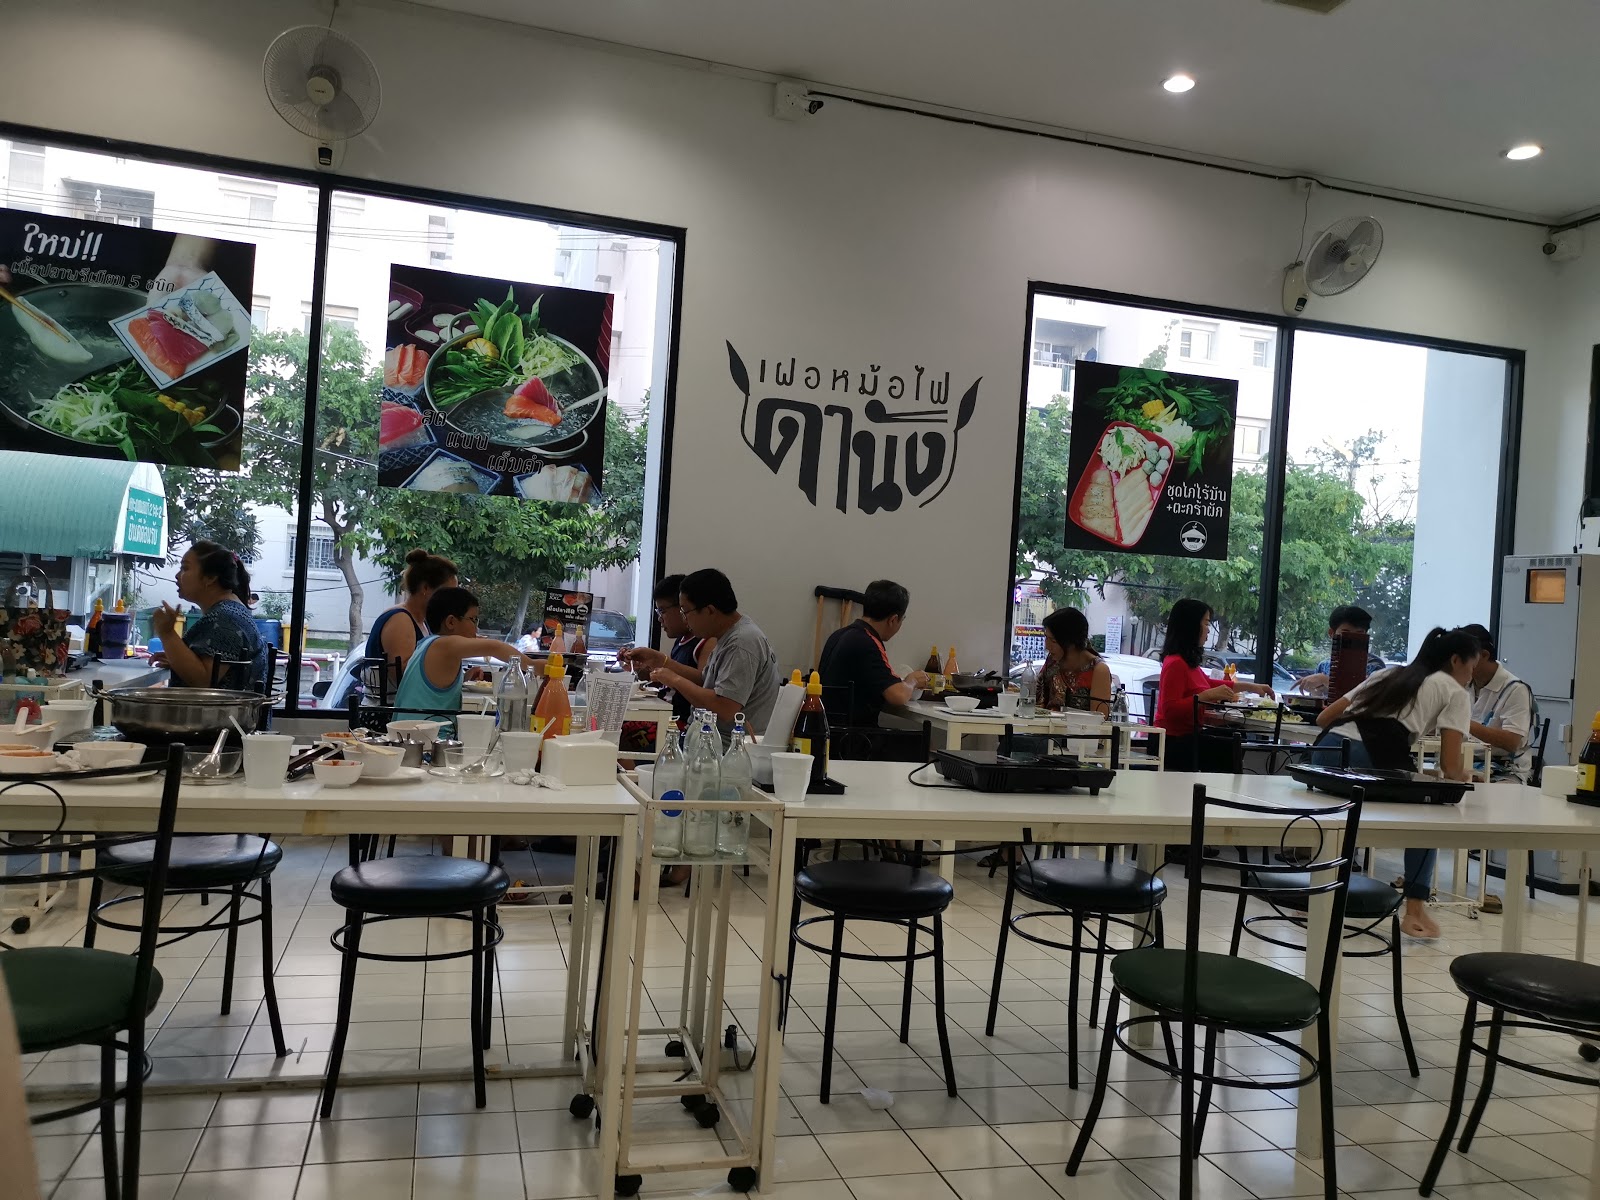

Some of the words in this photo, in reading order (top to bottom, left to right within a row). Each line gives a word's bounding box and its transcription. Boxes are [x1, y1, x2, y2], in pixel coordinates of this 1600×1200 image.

[23, 222, 103, 262] ใหม่!!
[10, 256, 126, 288] เนื้อปลาพรีเมียม
[128, 274, 142, 289] 5
[145, 278, 176, 293] ชนิด
[759, 357, 950, 405] เฝอหม้อไฟ
[421, 409, 447, 427] สด
[445, 427, 490, 451] แน่น
[486, 450, 545, 474] เต็มคำ
[1167, 481, 1227, 502] ชุดไก่ไร้มัน
[1166, 499, 1223, 518] +ตะกร้าผัก
